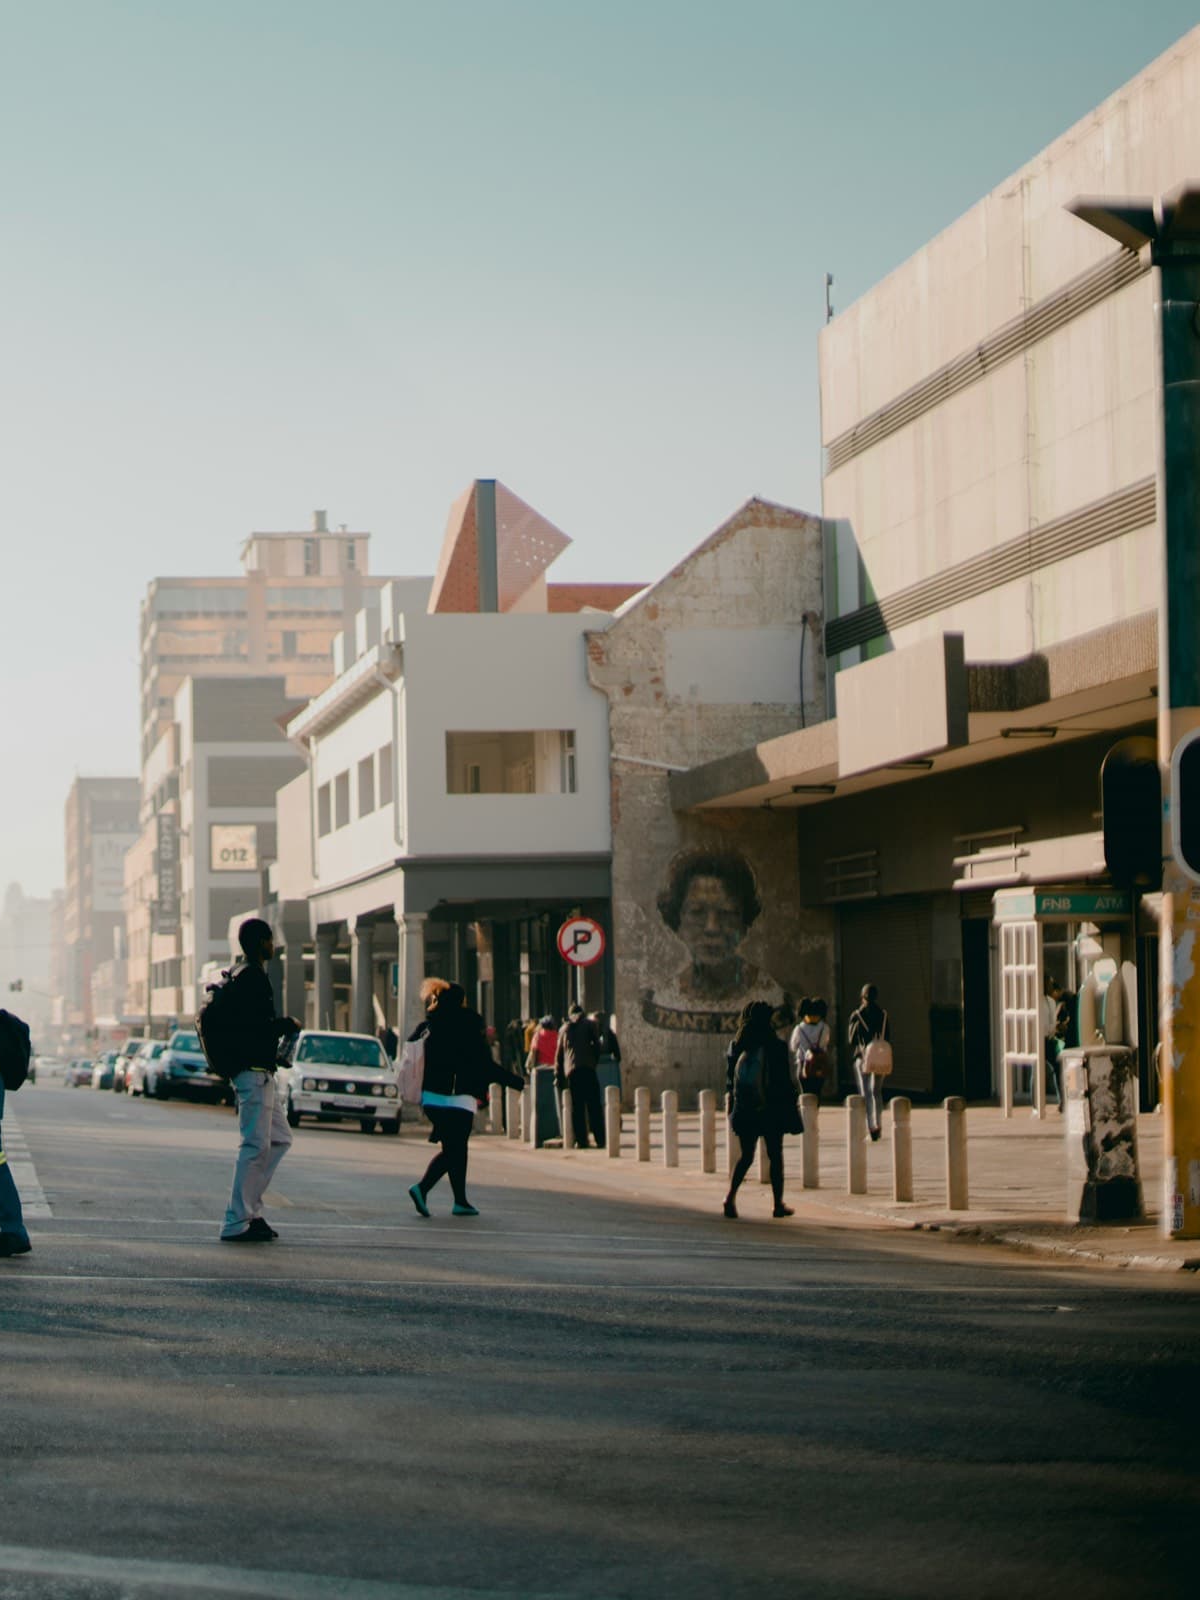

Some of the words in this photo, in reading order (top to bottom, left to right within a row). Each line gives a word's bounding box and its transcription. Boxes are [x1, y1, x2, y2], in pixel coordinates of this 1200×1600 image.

[1041, 897, 1072, 911] FNB
[1094, 895, 1124, 910] ATM
[573, 930, 592, 954] P
